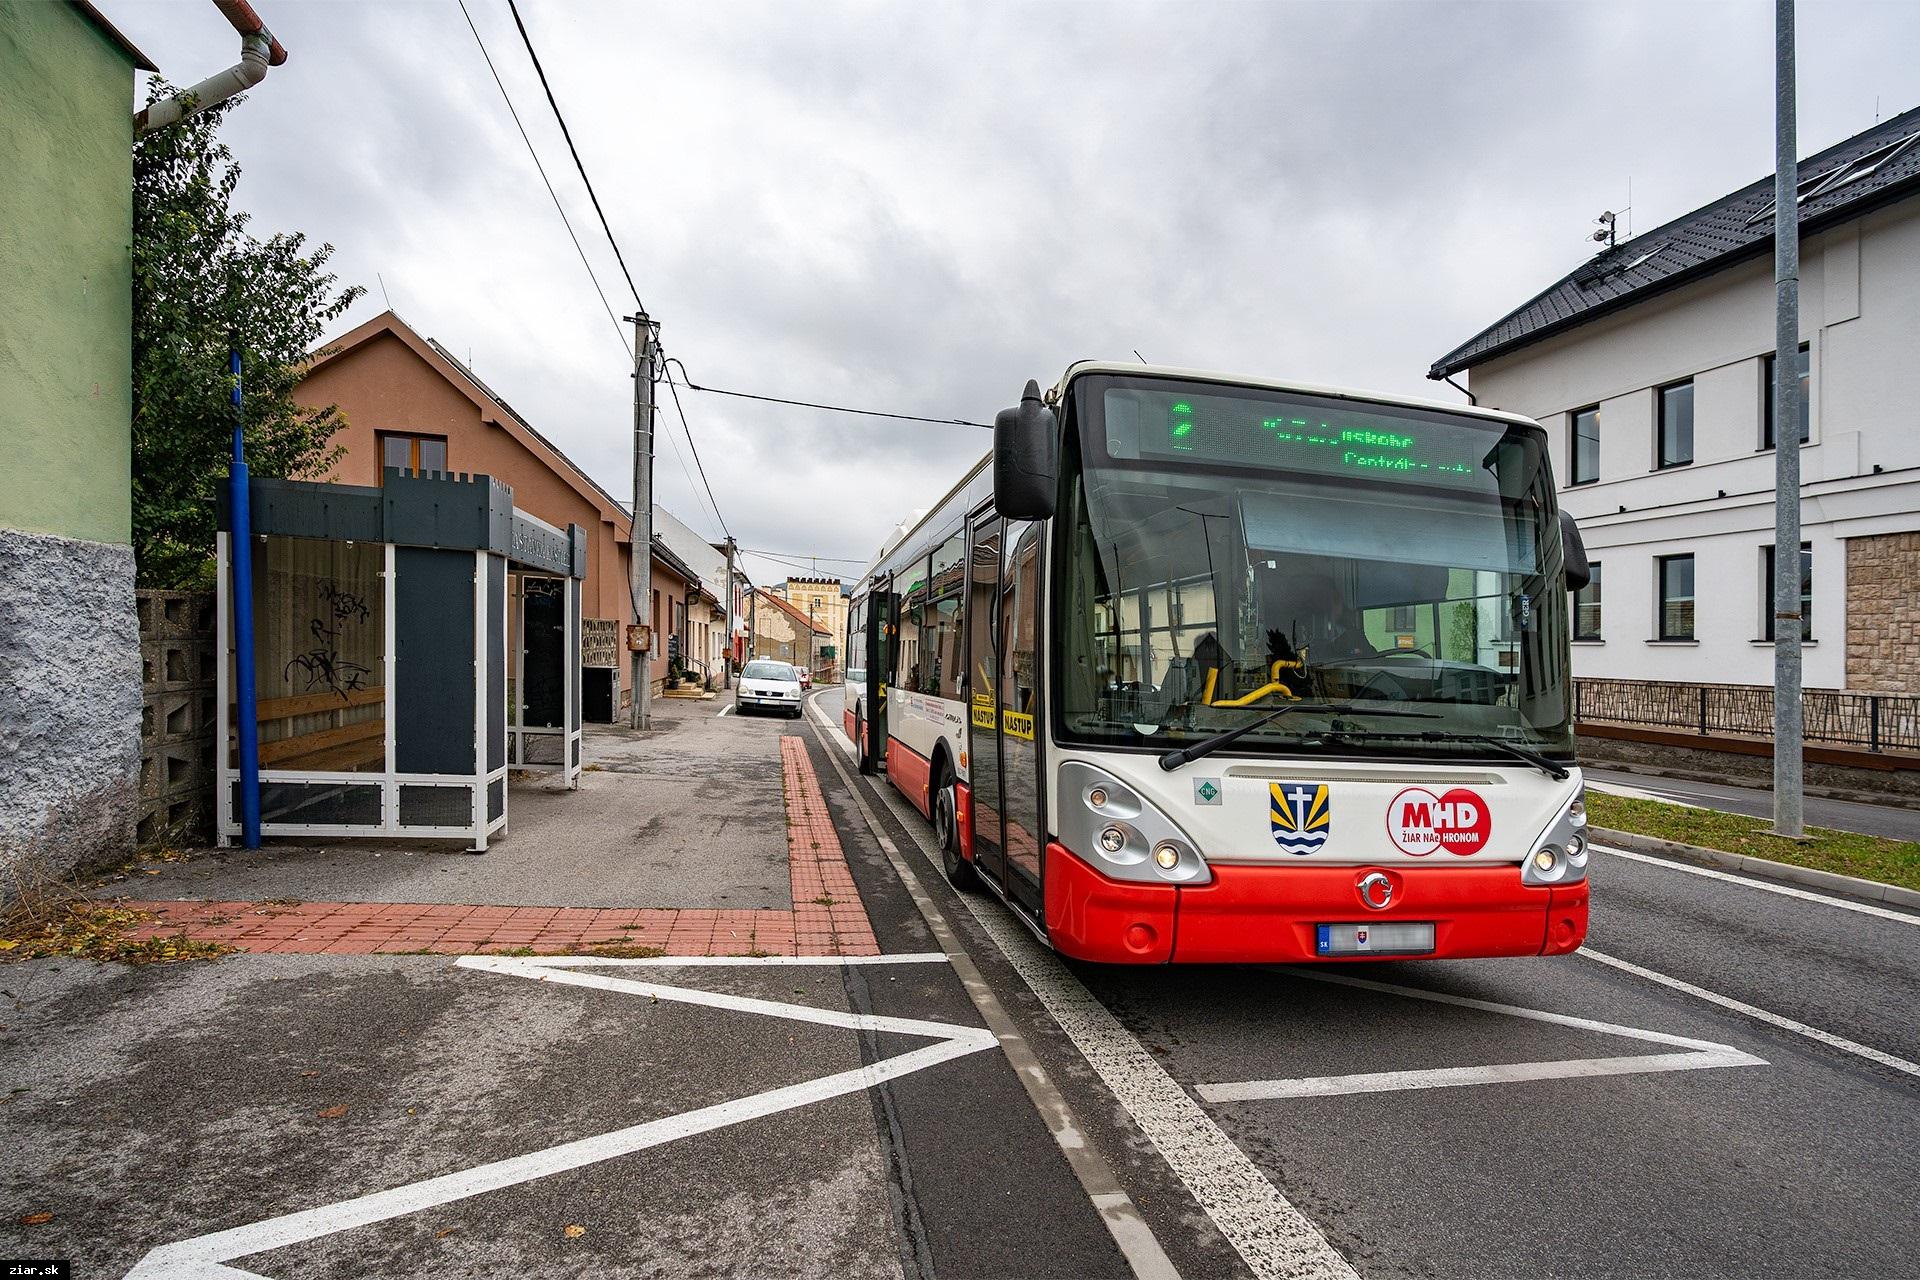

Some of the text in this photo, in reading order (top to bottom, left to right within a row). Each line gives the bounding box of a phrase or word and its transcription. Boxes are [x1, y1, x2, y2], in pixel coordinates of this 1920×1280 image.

[1201, 787, 1216, 796] CNG
[1401, 802, 1478, 829] MHD
[1402, 830, 1480, 843] ŽIAR NAD HRONOM
